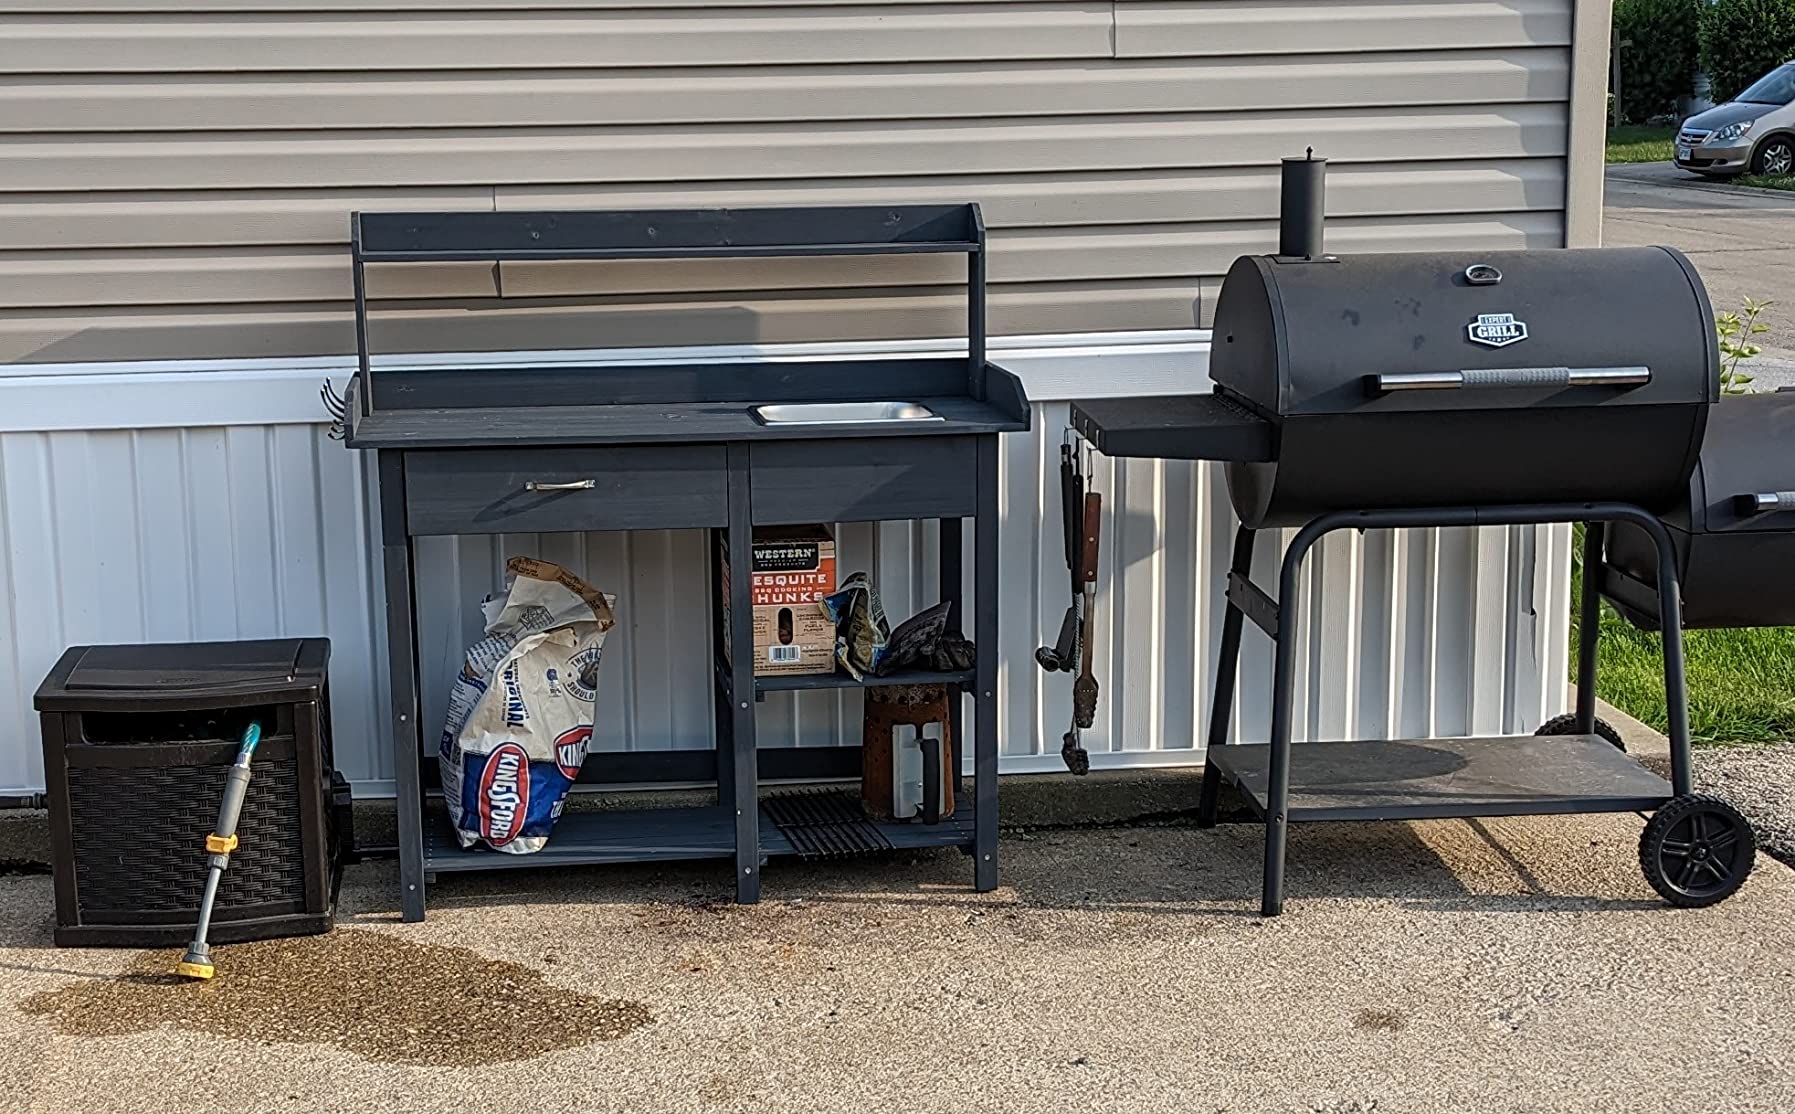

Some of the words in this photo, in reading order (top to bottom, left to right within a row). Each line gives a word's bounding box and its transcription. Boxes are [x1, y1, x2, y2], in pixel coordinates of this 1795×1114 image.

[1477, 324, 1520, 338] GRILL
[754, 548, 813, 559] WESTERN
[754, 574, 827, 587] ESQUITE
[757, 591, 824, 604] HUNKS
[570, 655, 585, 668] THE
[567, 681, 594, 700] SHOULD
[487, 752, 521, 839] KINGSFORD
